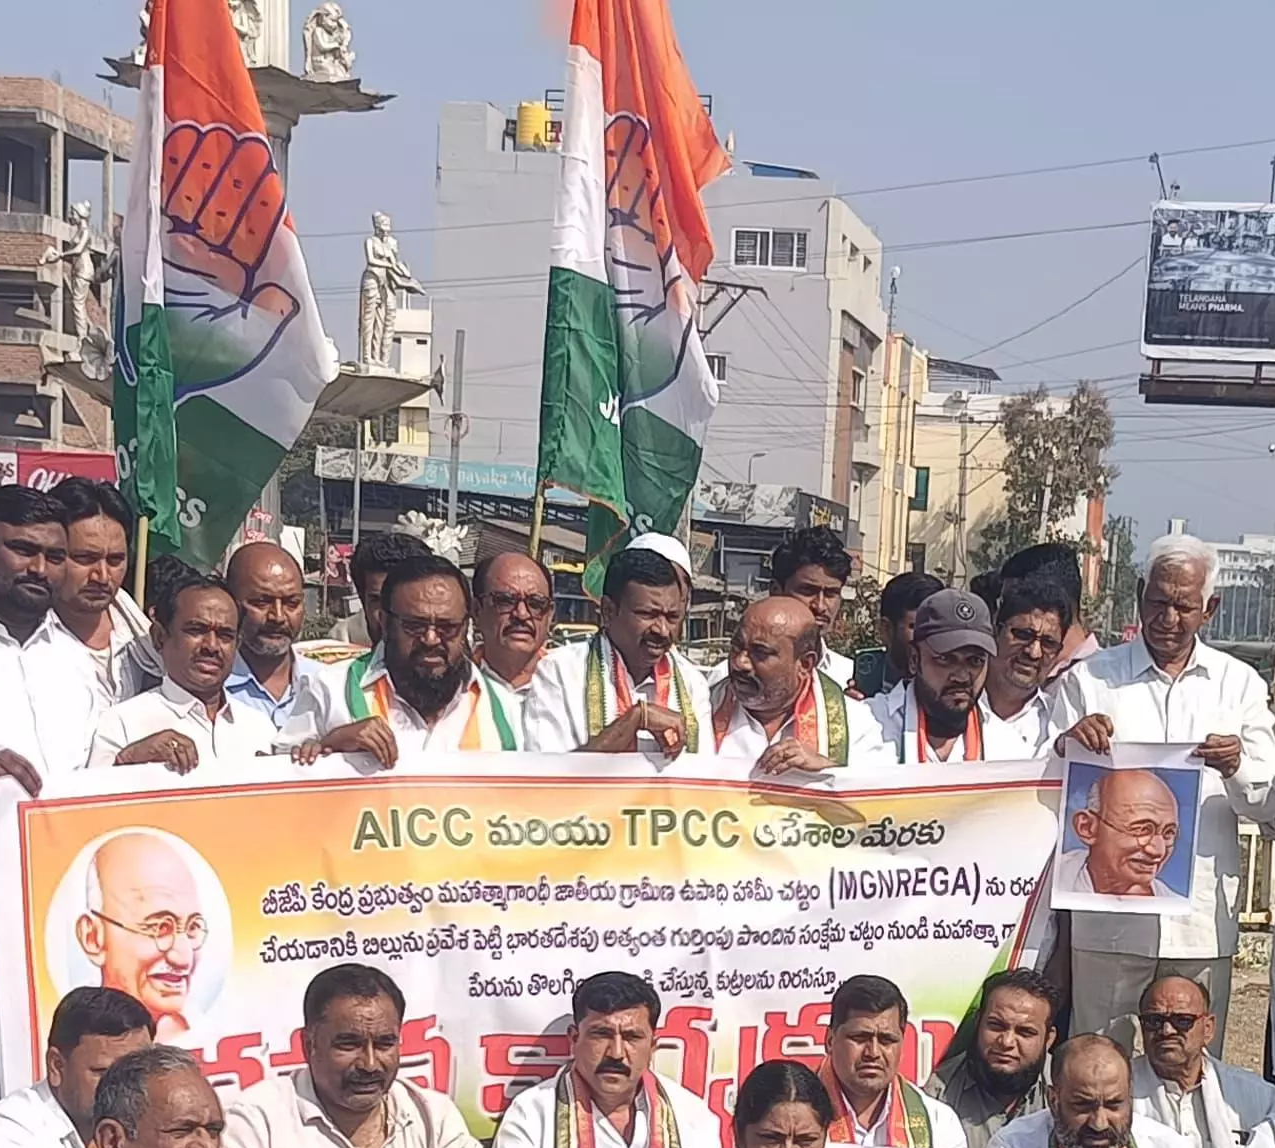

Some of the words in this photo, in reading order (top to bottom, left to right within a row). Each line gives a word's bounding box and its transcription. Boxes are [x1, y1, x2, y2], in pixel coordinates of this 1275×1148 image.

[353, 807, 473, 850] AICC
[487, 814, 611, 847] మరియు
[621, 808, 740, 848] TPCC
[860, 816, 945, 847] మేరకు
[262, 881, 307, 915] బీజేపీ
[311, 881, 356, 916] కేంద్ర
[357, 882, 433, 914] ప్రభుత్వం
[554, 875, 616, 902] జాతీయ
[618, 876, 675, 909] గ్రామీణ
[678, 878, 729, 905] ఉపాధి
[732, 876, 773, 901] హామీ
[777, 879, 821, 911] చట్టం
[829, 861, 981, 910] (MGNREGA)
[260, 931, 358, 963] చేయడానికి
[603, 925, 667, 957] అత్యంత
[670, 925, 734, 956] గుర్తింపు
[736, 924, 796, 946] పొందిన
[799, 918, 845, 951] సంక్షేమ
[849, 919, 884, 950] చట్టం
[887, 916, 929, 940] నుండి
[468, 971, 523, 999] పేరును
[659, 967, 713, 1000] చేస్తున్న
